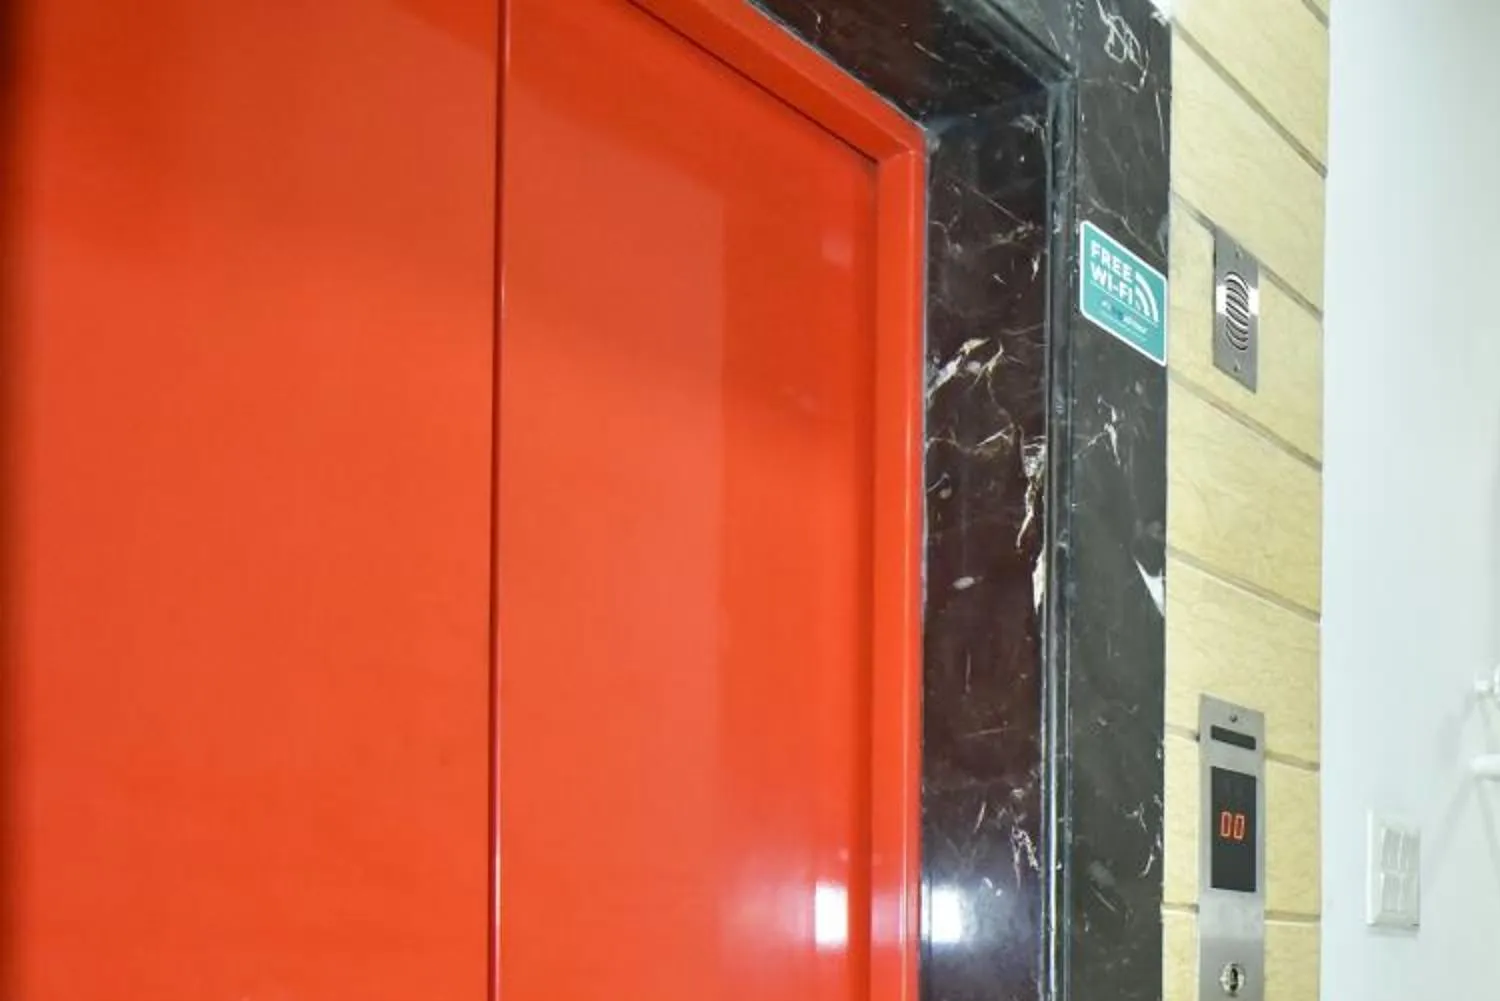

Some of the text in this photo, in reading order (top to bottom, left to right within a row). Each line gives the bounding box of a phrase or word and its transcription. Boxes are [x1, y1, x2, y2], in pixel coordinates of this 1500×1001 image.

[1090, 240, 1133, 283] FREE
[1090, 262, 1133, 305] WI-FI
[1220, 811, 1245, 840] 00
